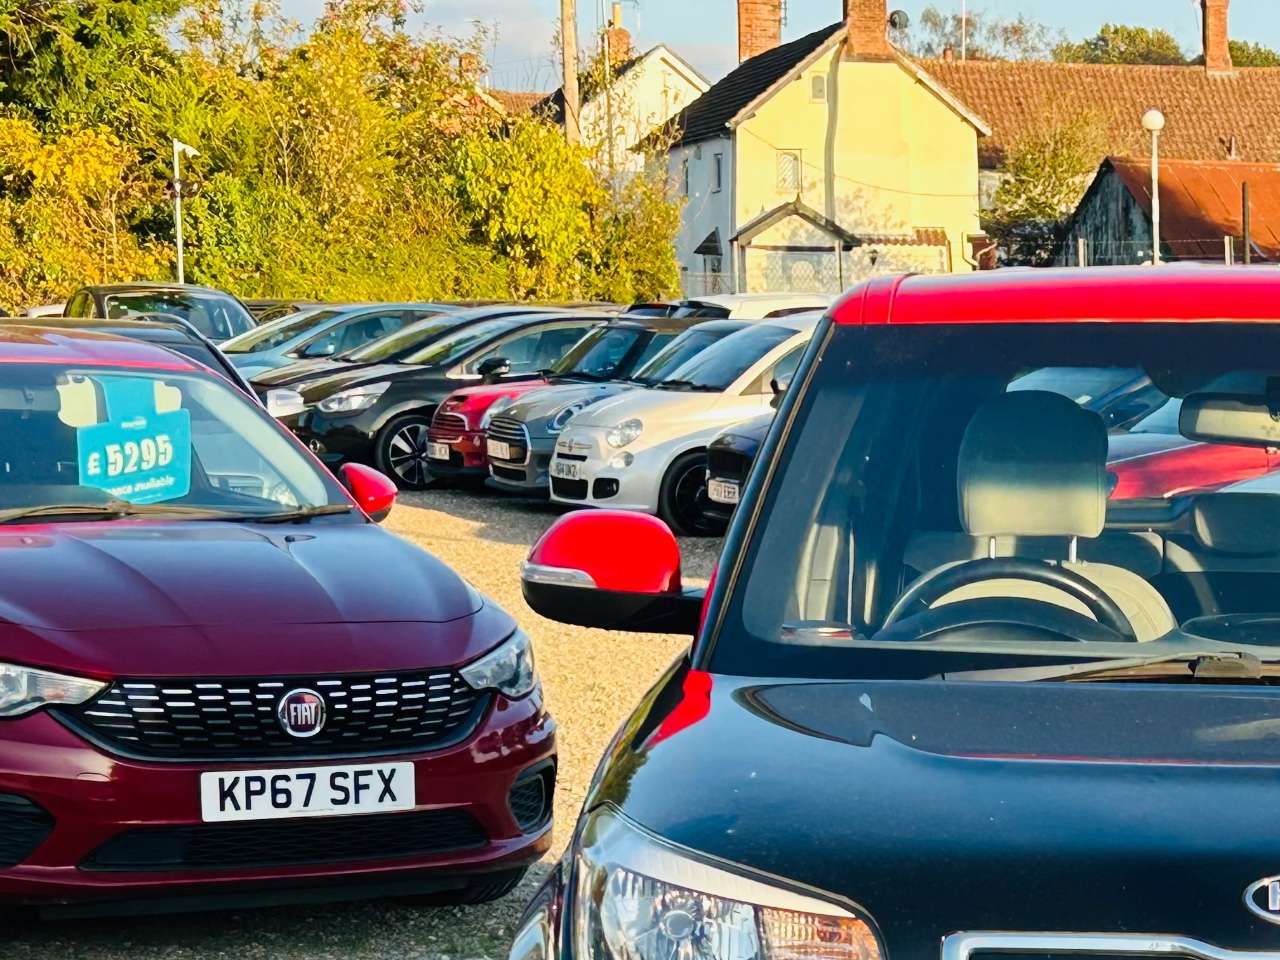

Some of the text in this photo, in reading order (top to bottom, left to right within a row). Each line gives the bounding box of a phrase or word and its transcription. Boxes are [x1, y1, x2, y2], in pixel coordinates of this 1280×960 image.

[289, 702, 318, 725] FIAT
[218, 767, 398, 812] KP67 SFX
